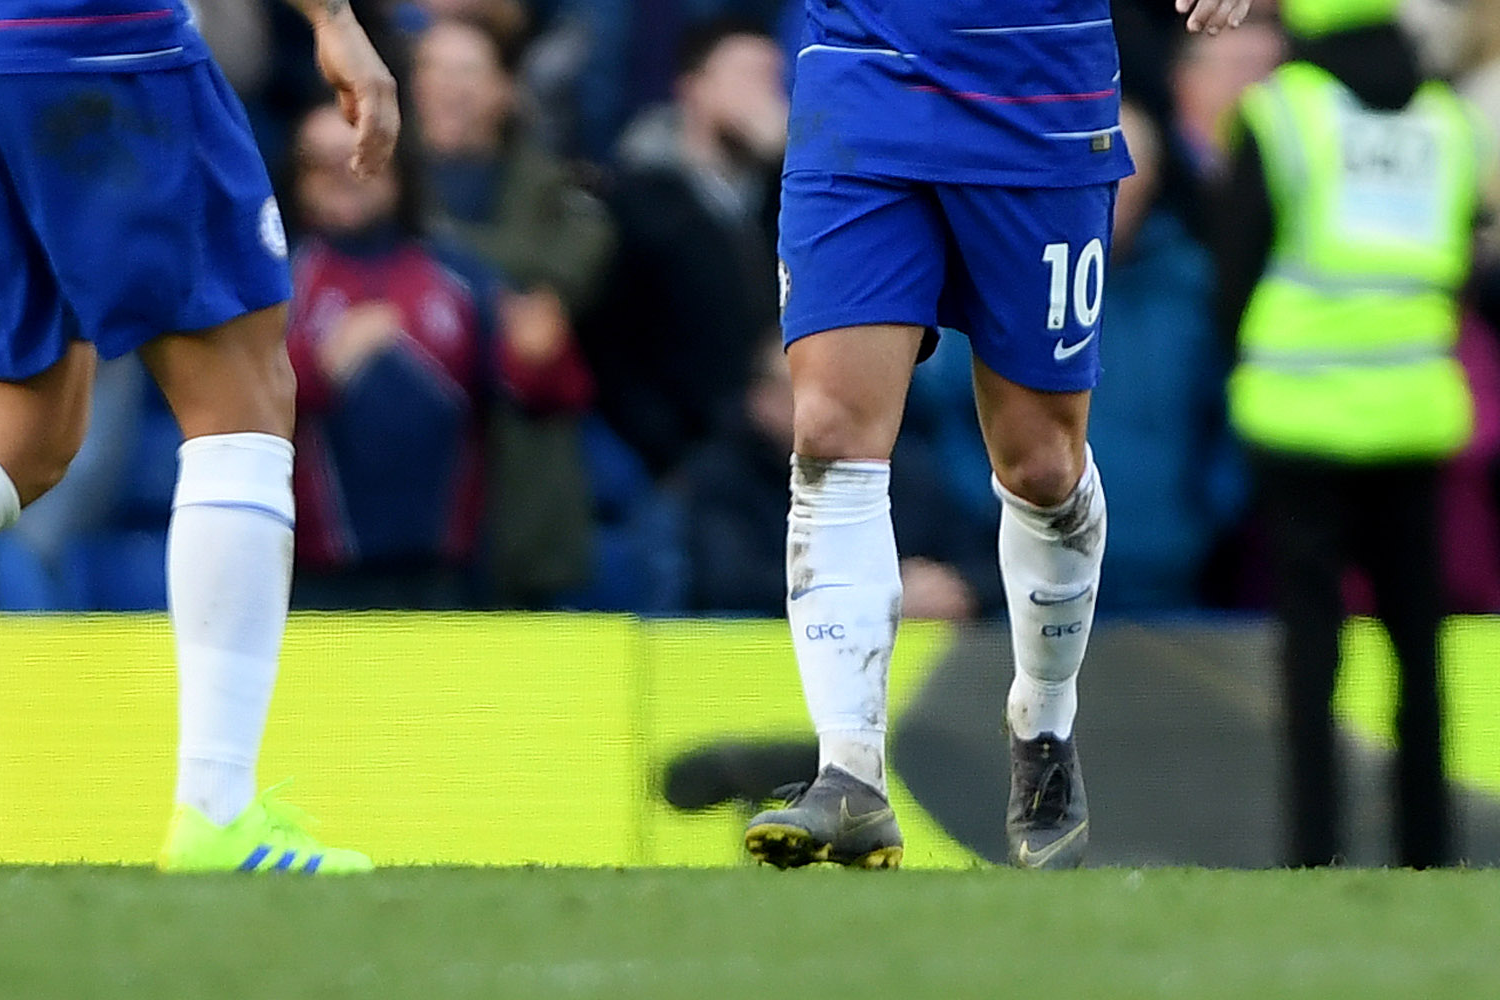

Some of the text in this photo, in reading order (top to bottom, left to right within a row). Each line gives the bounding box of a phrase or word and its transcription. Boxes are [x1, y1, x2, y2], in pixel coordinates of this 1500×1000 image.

[1042, 238, 1104, 330] 10
[806, 624, 845, 640] CFC
[1041, 621, 1082, 638] CFC
